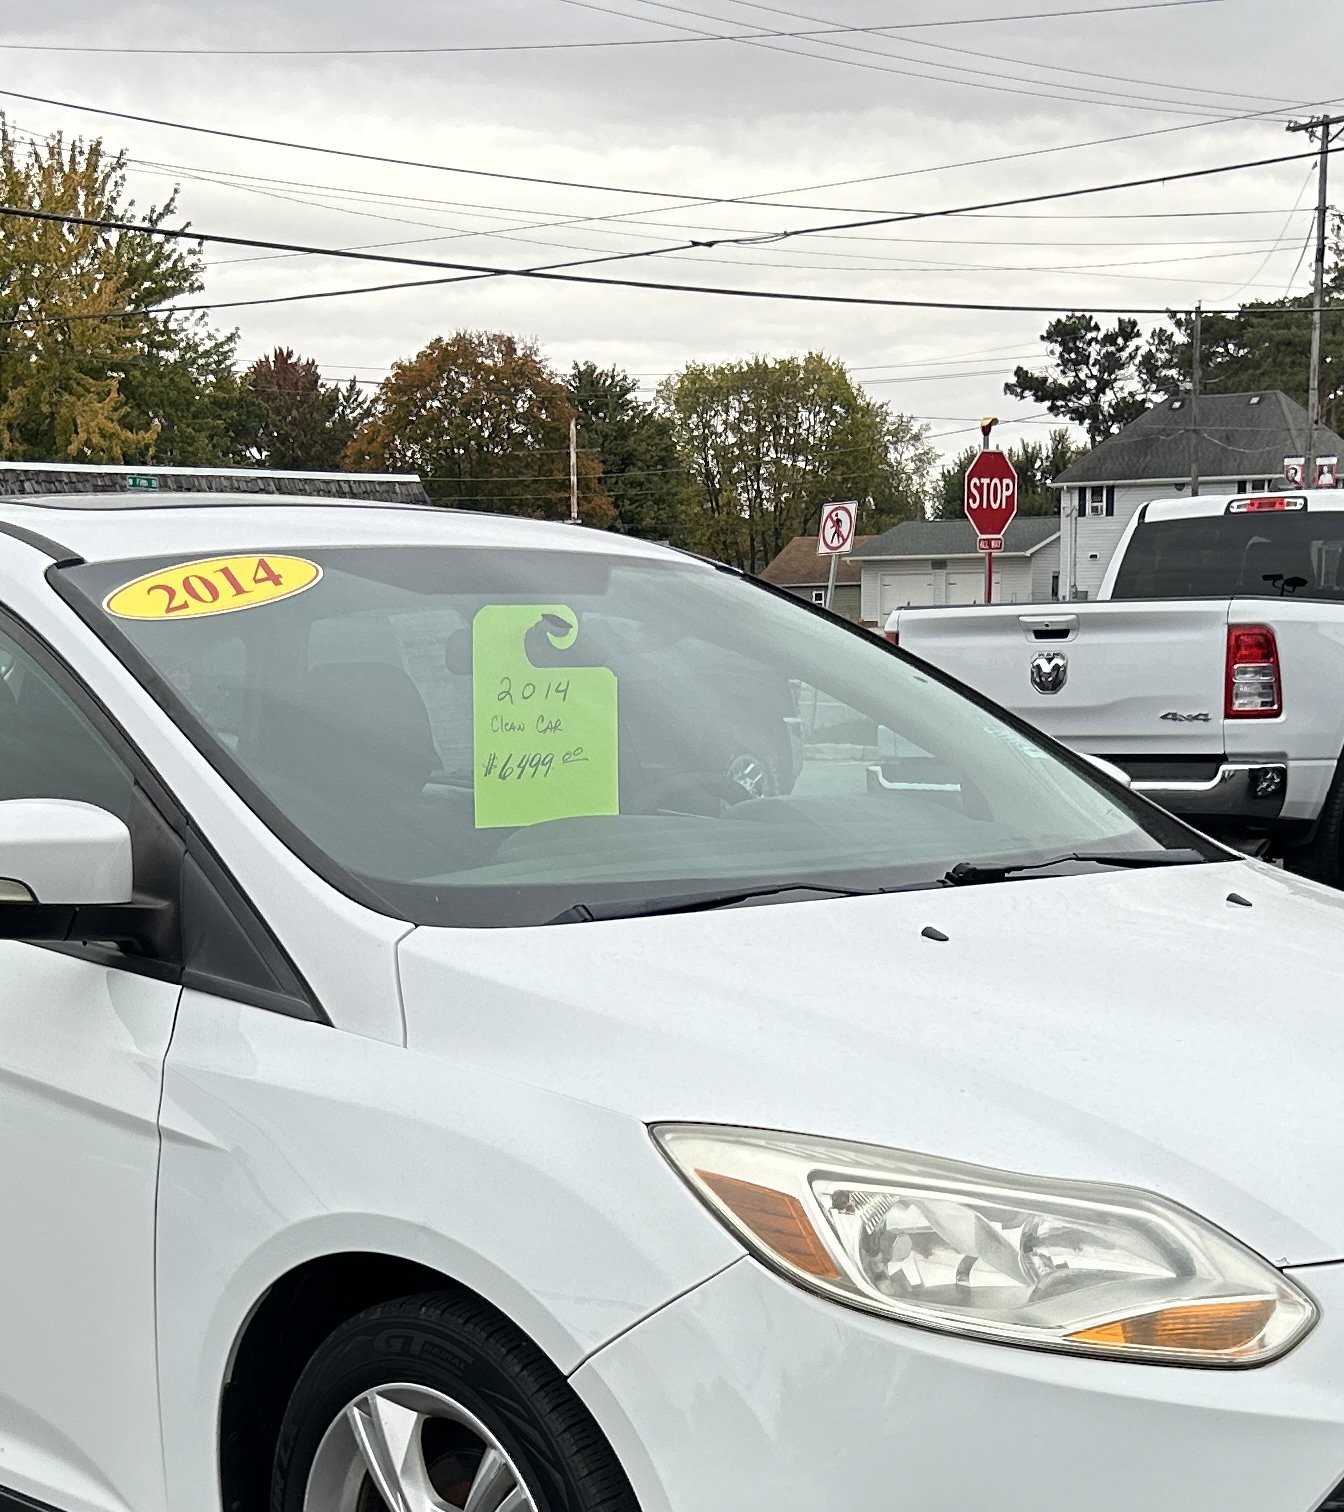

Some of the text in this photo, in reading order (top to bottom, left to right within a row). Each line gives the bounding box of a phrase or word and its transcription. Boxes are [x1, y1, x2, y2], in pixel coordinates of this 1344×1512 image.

[968, 477, 1014, 510] STOP
[147, 558, 283, 614] 2014
[497, 676, 571, 706] 2014
